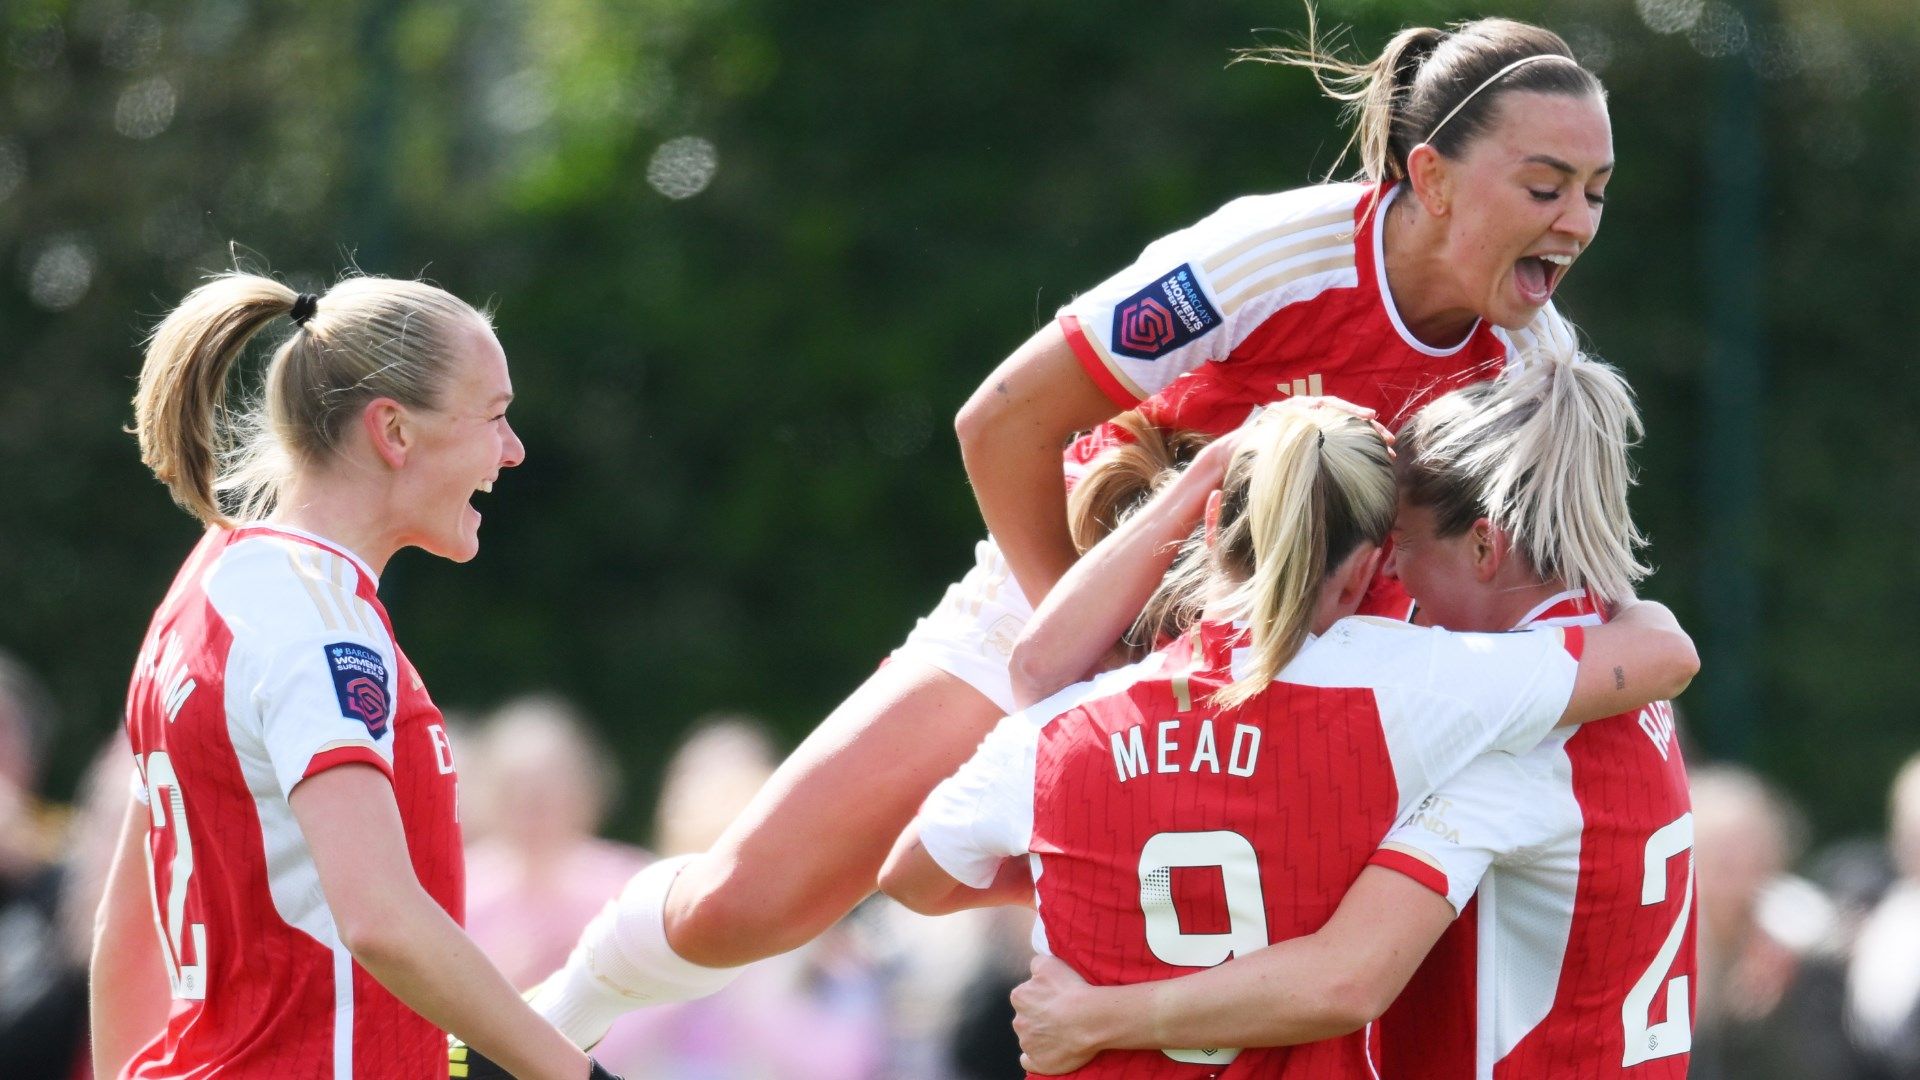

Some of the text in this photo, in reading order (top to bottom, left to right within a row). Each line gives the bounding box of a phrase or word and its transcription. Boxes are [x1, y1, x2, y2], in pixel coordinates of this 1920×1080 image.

[1161, 281, 1196, 333] SUPER LEAGUE
[1168, 276, 1204, 331] WOMEN'S
[1181, 281, 1213, 324] BARCLAYS
[334, 656, 385, 676] WOMEN'S
[337, 664, 363, 673] SUPER
[1110, 719, 1262, 784] MEAD
[1138, 830, 1270, 1065] 9
